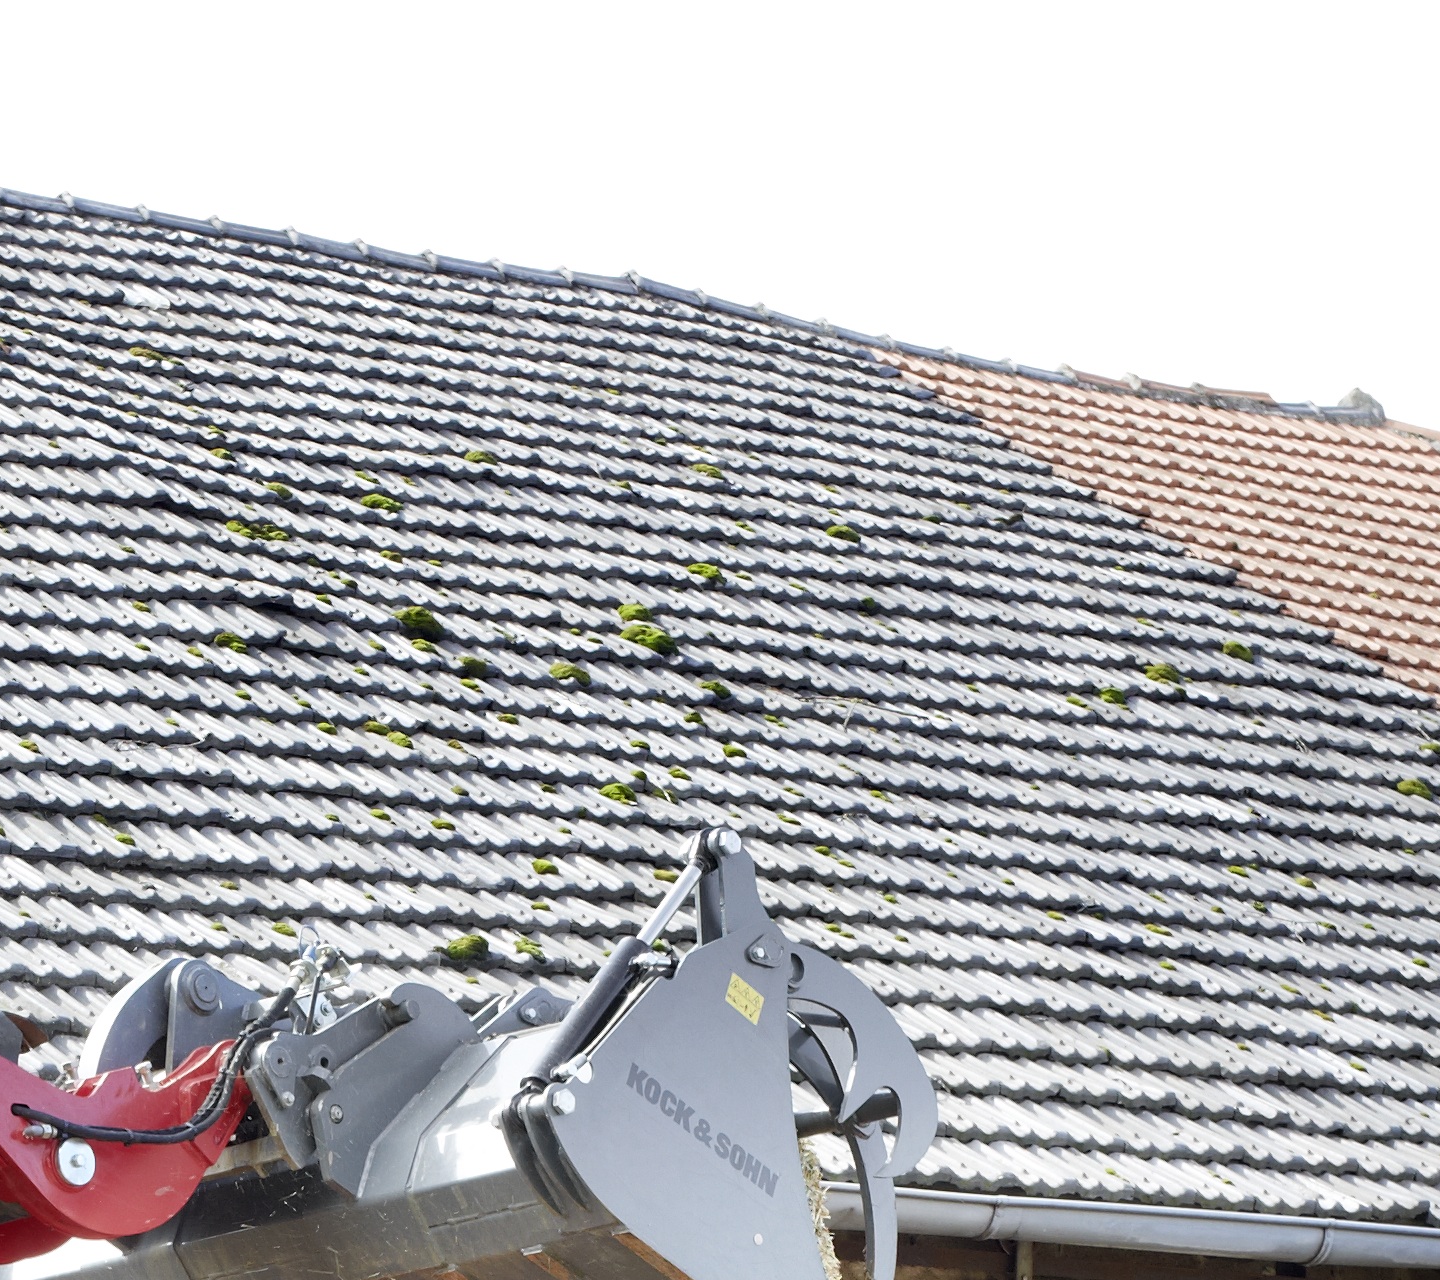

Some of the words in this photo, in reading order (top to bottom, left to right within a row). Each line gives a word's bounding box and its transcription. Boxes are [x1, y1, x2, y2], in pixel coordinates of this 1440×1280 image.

[626, 1062, 695, 1133] KOCK
[693, 1118, 712, 1148] &
[714, 1132, 779, 1198] SOHN
